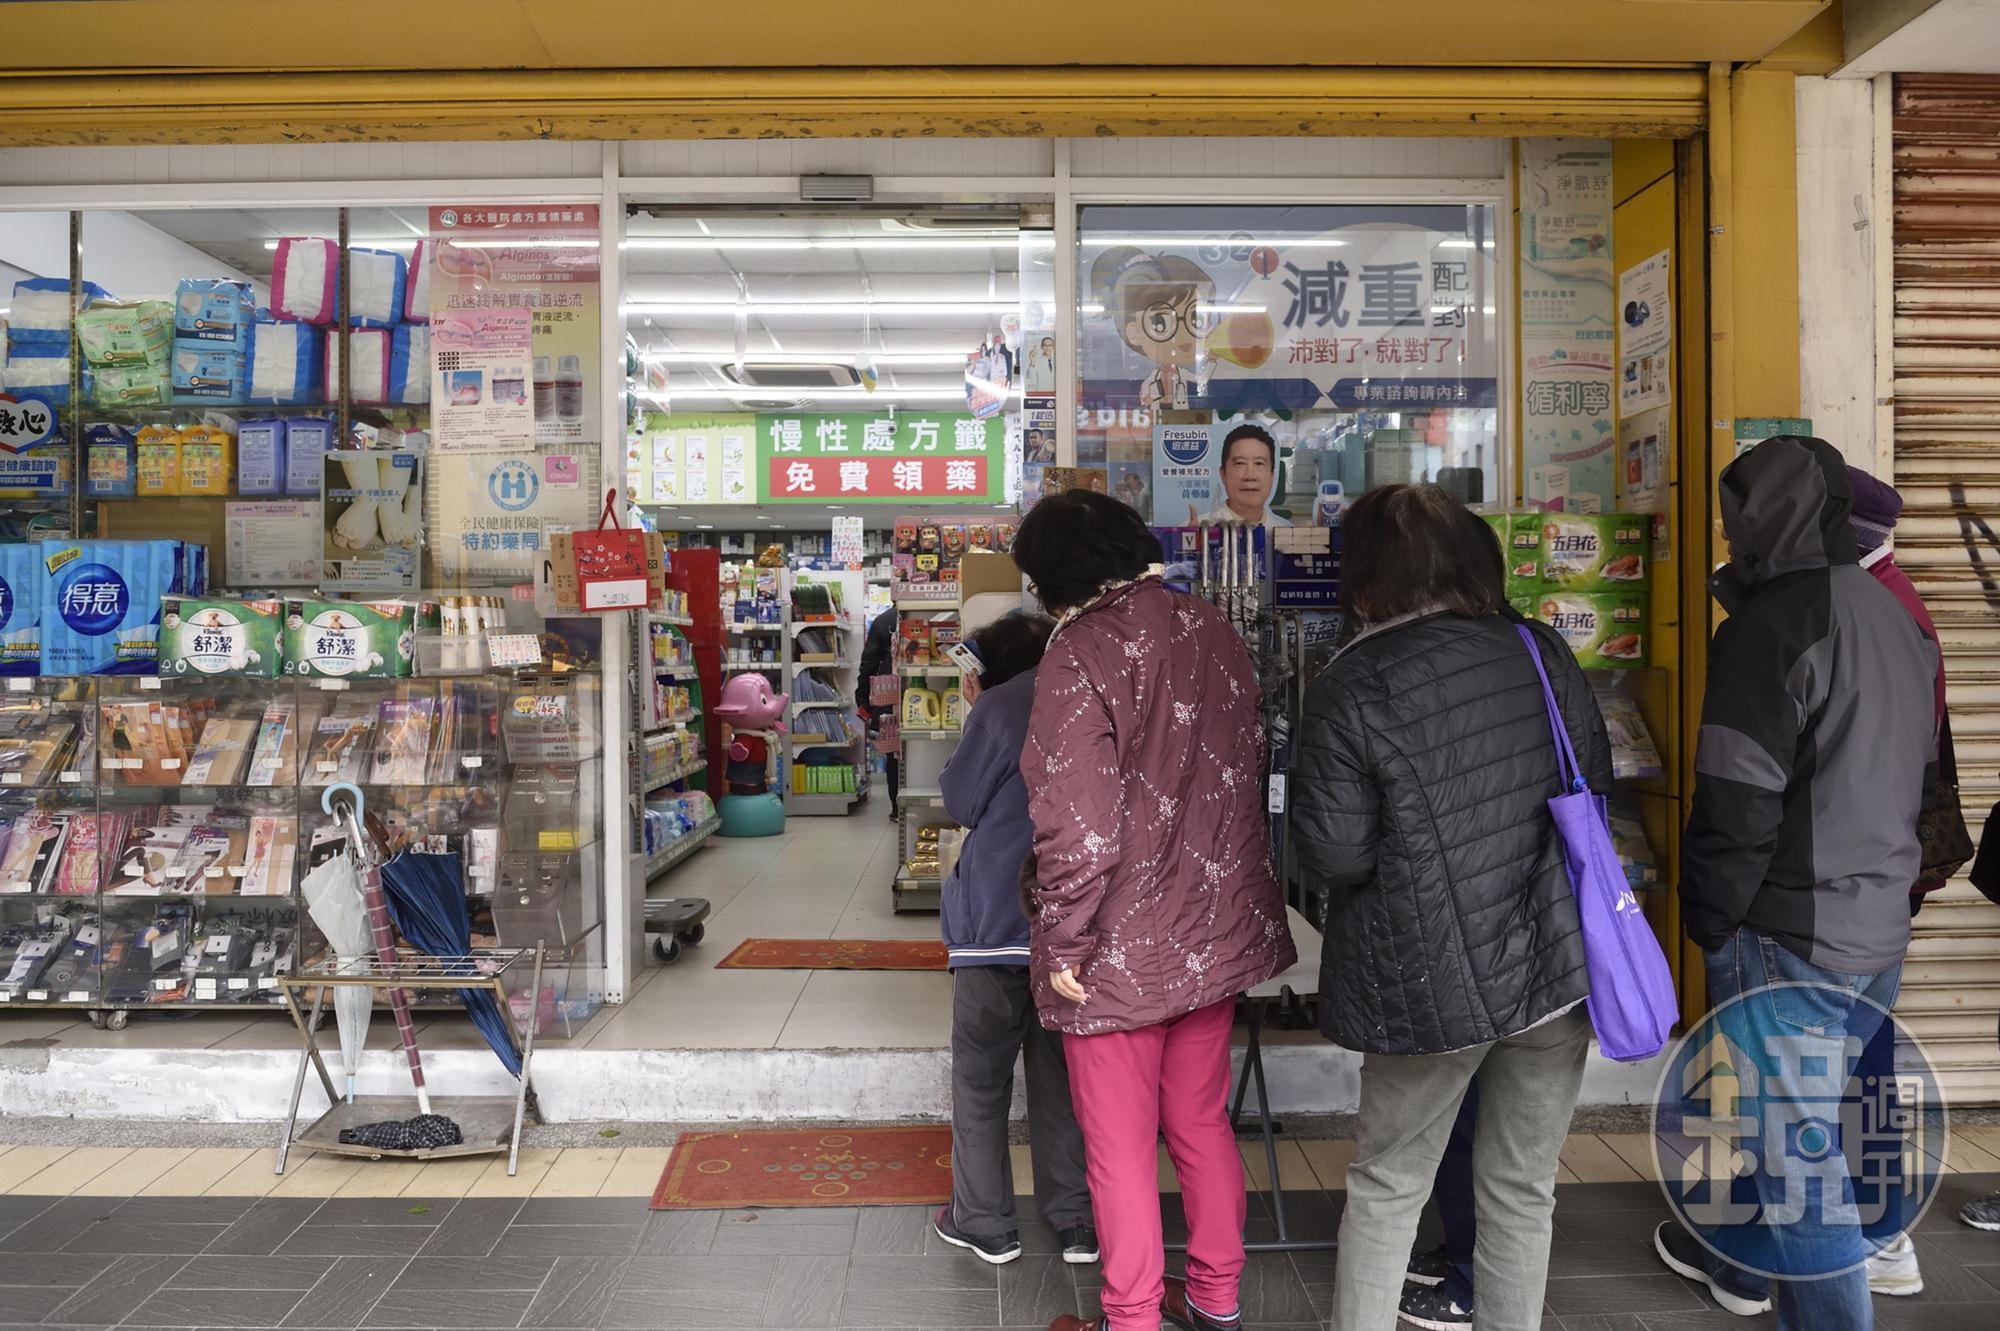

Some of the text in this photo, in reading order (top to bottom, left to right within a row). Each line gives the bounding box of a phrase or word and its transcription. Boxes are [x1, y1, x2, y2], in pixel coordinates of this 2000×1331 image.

[446, 292, 584, 309] 迅速緩解胃食道逆流
[1282, 260, 1427, 329] 減重
[1431, 261, 1469, 328] 配對
[1353, 385, 1469, 401] 專業諮詢請內洽
[1527, 380, 1611, 416] 循利寧
[769, 418, 987, 453] 慢性處方籤
[1164, 430, 1208, 439] Fresubin
[786, 461, 977, 493] 免費領藥
[460, 516, 540, 530] 全民健康保險
[461, 532, 540, 550] 特約藥局
[1551, 535, 1599, 551] 五月花
[62, 582, 121, 616] 得意
[1550, 612, 1597, 629] 五月花
[193, 635, 233, 653] 舒潔
[316, 636, 356, 655] 舒潔
